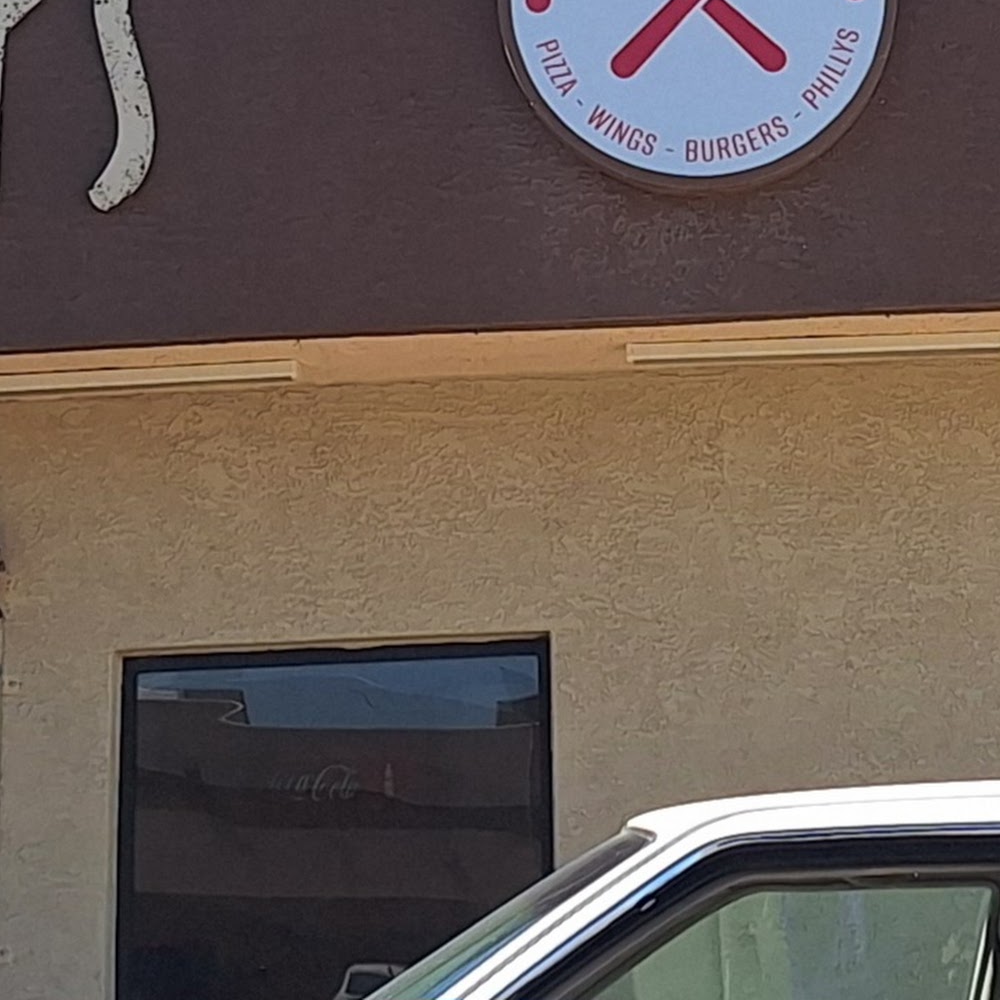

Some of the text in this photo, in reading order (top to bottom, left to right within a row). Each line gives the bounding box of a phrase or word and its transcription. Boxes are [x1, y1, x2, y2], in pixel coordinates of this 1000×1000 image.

[536, 38, 578, 98] PIZZA
[586, 104, 658, 157] WINGS
[684, 115, 790, 163] BURGERS
[800, 27, 861, 111] PHILLYS
